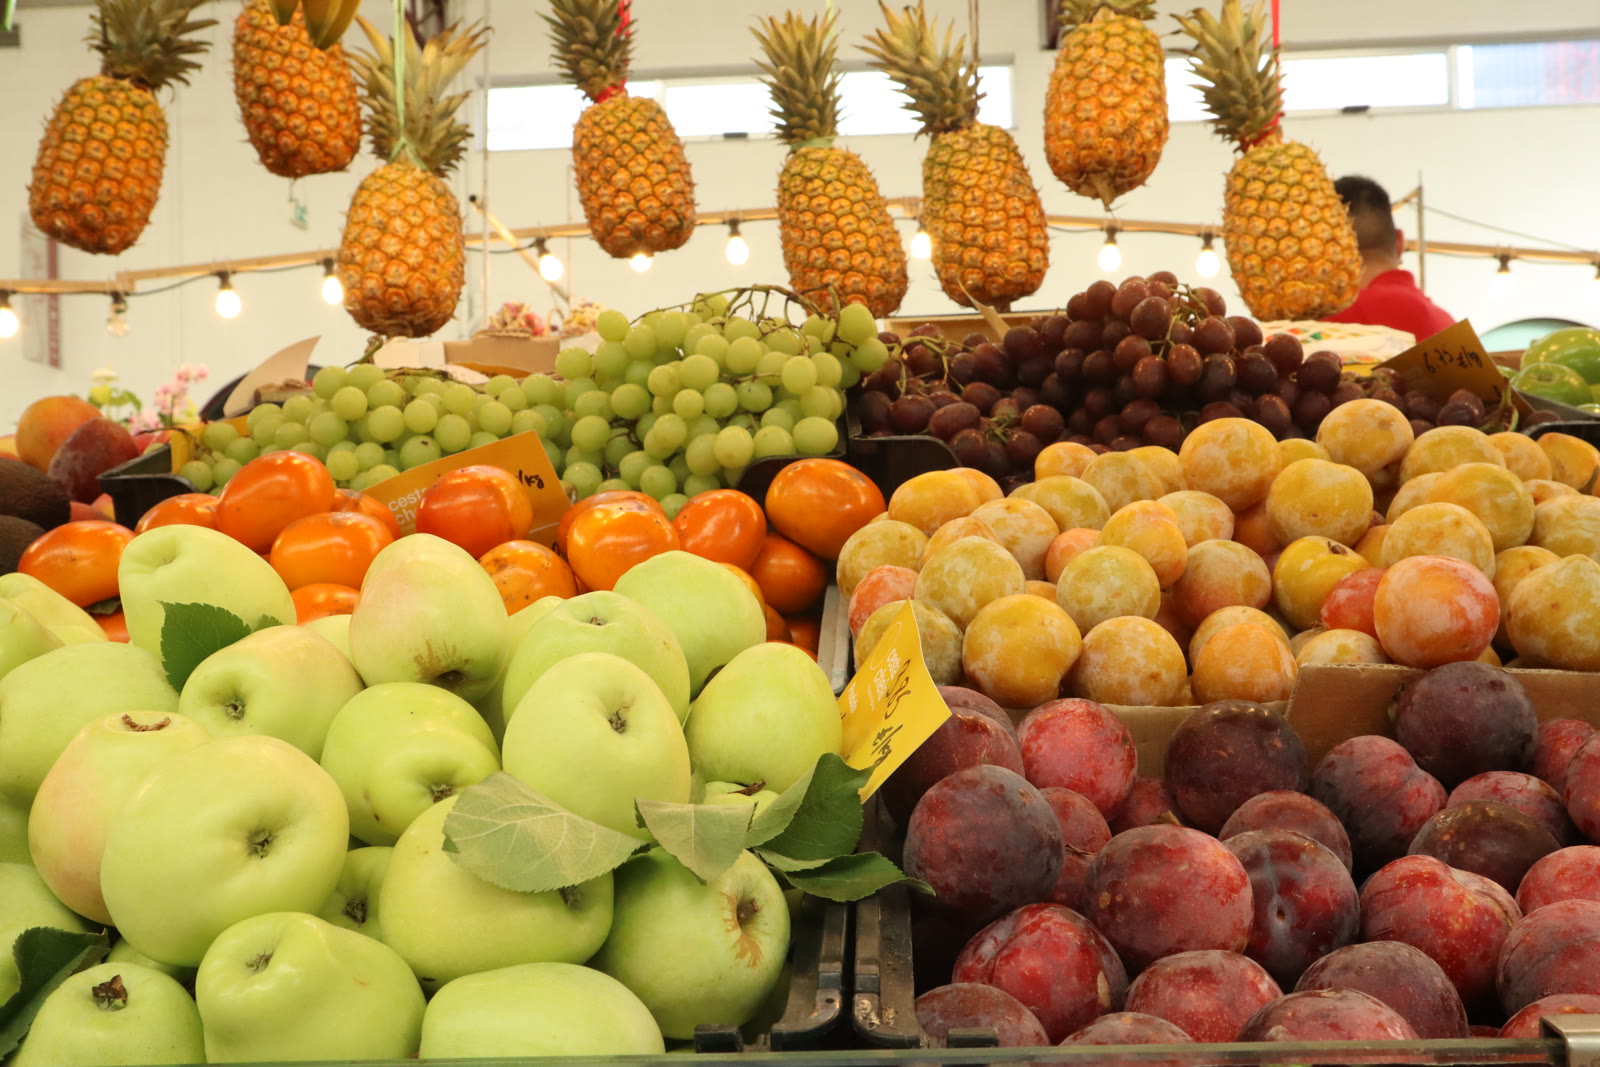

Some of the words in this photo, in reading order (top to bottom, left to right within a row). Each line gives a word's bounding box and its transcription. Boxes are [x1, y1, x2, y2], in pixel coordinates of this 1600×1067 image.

[395, 508, 417, 526] ch
[886, 648, 901, 681] cesta
[873, 667, 890, 702] cheia
